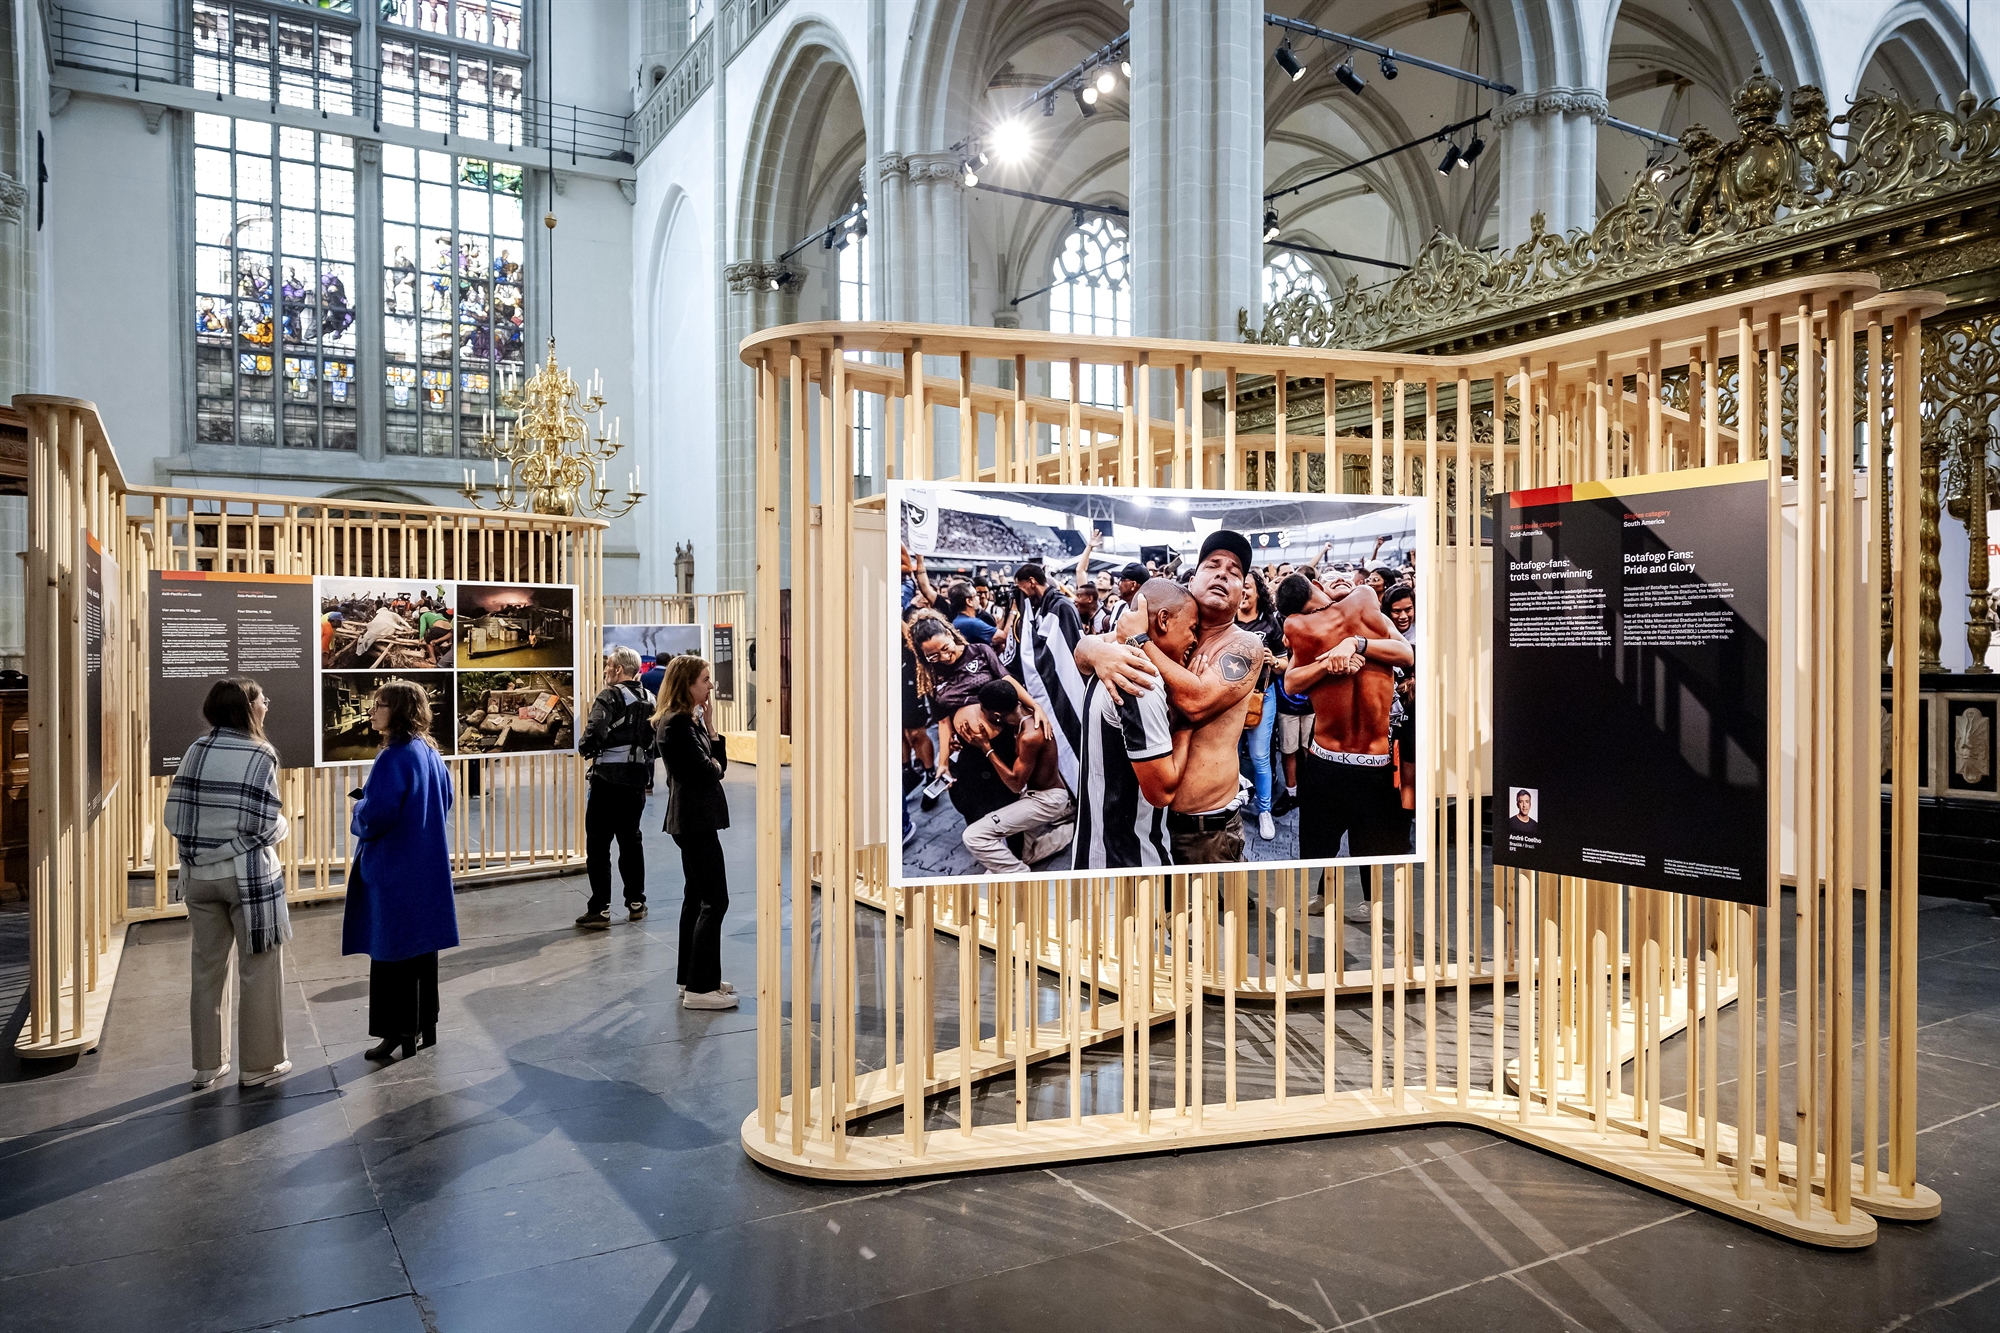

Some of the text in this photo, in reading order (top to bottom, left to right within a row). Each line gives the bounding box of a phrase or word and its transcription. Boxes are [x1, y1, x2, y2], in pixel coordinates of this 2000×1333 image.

[1624, 551, 1694, 563] Botafogo Fans:
[1510, 559, 1570, 571] Botafogo-fans:
[1624, 562, 1696, 574] Pride and Glory
[1510, 573, 1529, 581] trots
[1542, 569, 1593, 579] overwinning
[1315, 747, 1333, 761] Klein
